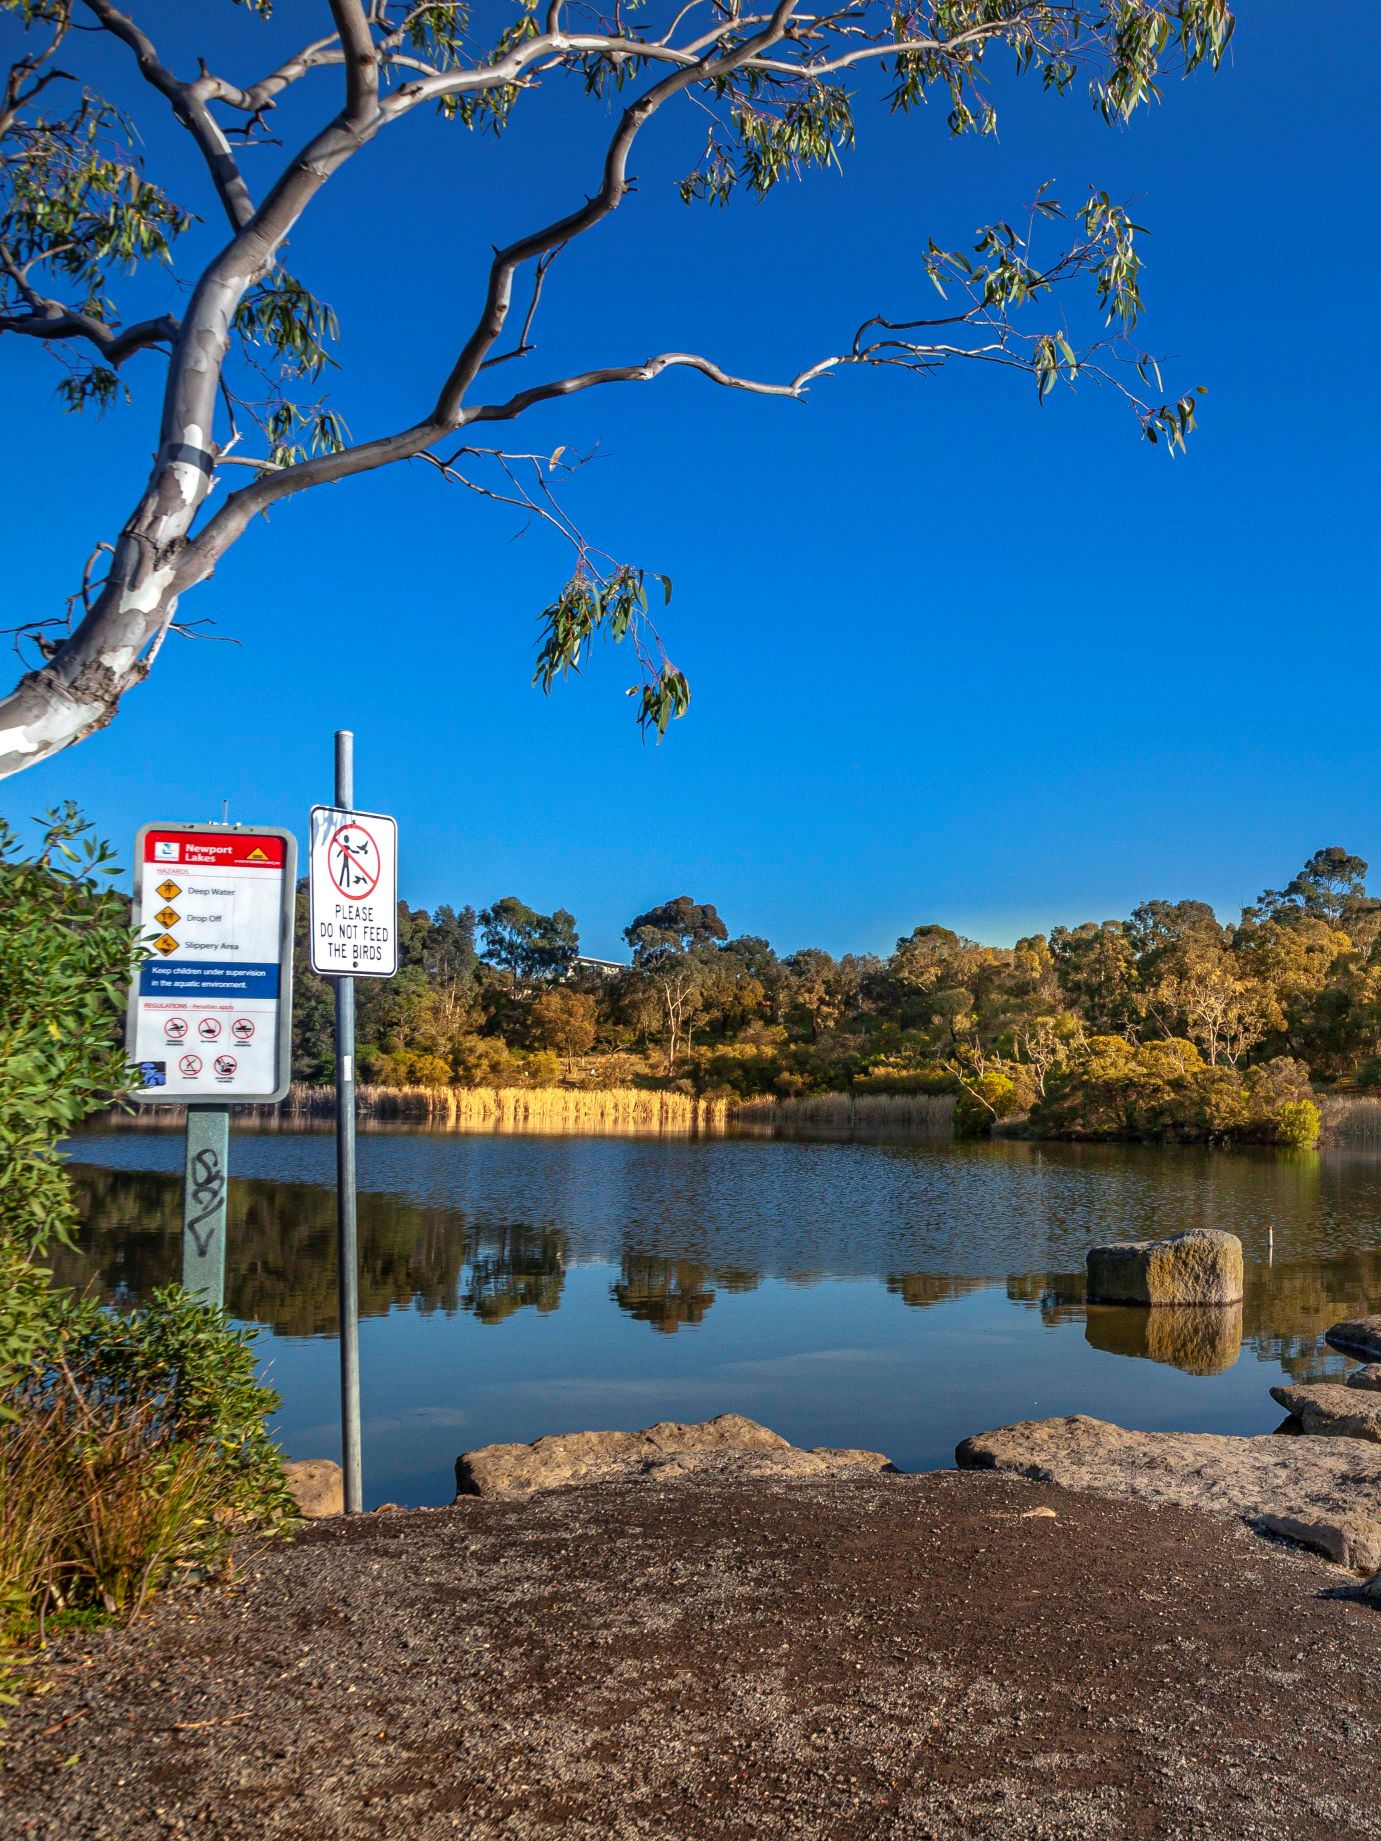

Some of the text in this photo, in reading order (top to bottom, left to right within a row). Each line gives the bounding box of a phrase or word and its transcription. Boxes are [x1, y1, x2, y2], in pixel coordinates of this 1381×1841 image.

[185, 844, 232, 854] Newport
[185, 854, 216, 862] Lakes
[188, 887, 236, 896] Deep Water
[335, 904, 374, 922] PLEASE
[186, 914, 207, 922] Drop
[320, 923, 389, 942] DO NOT FEED
[185, 942, 218, 951] Slippery
[328, 942, 382, 961] THE BIRDS
[151, 967, 266, 977] Keep children under supervision
[173, 981, 200, 989] aquatic
